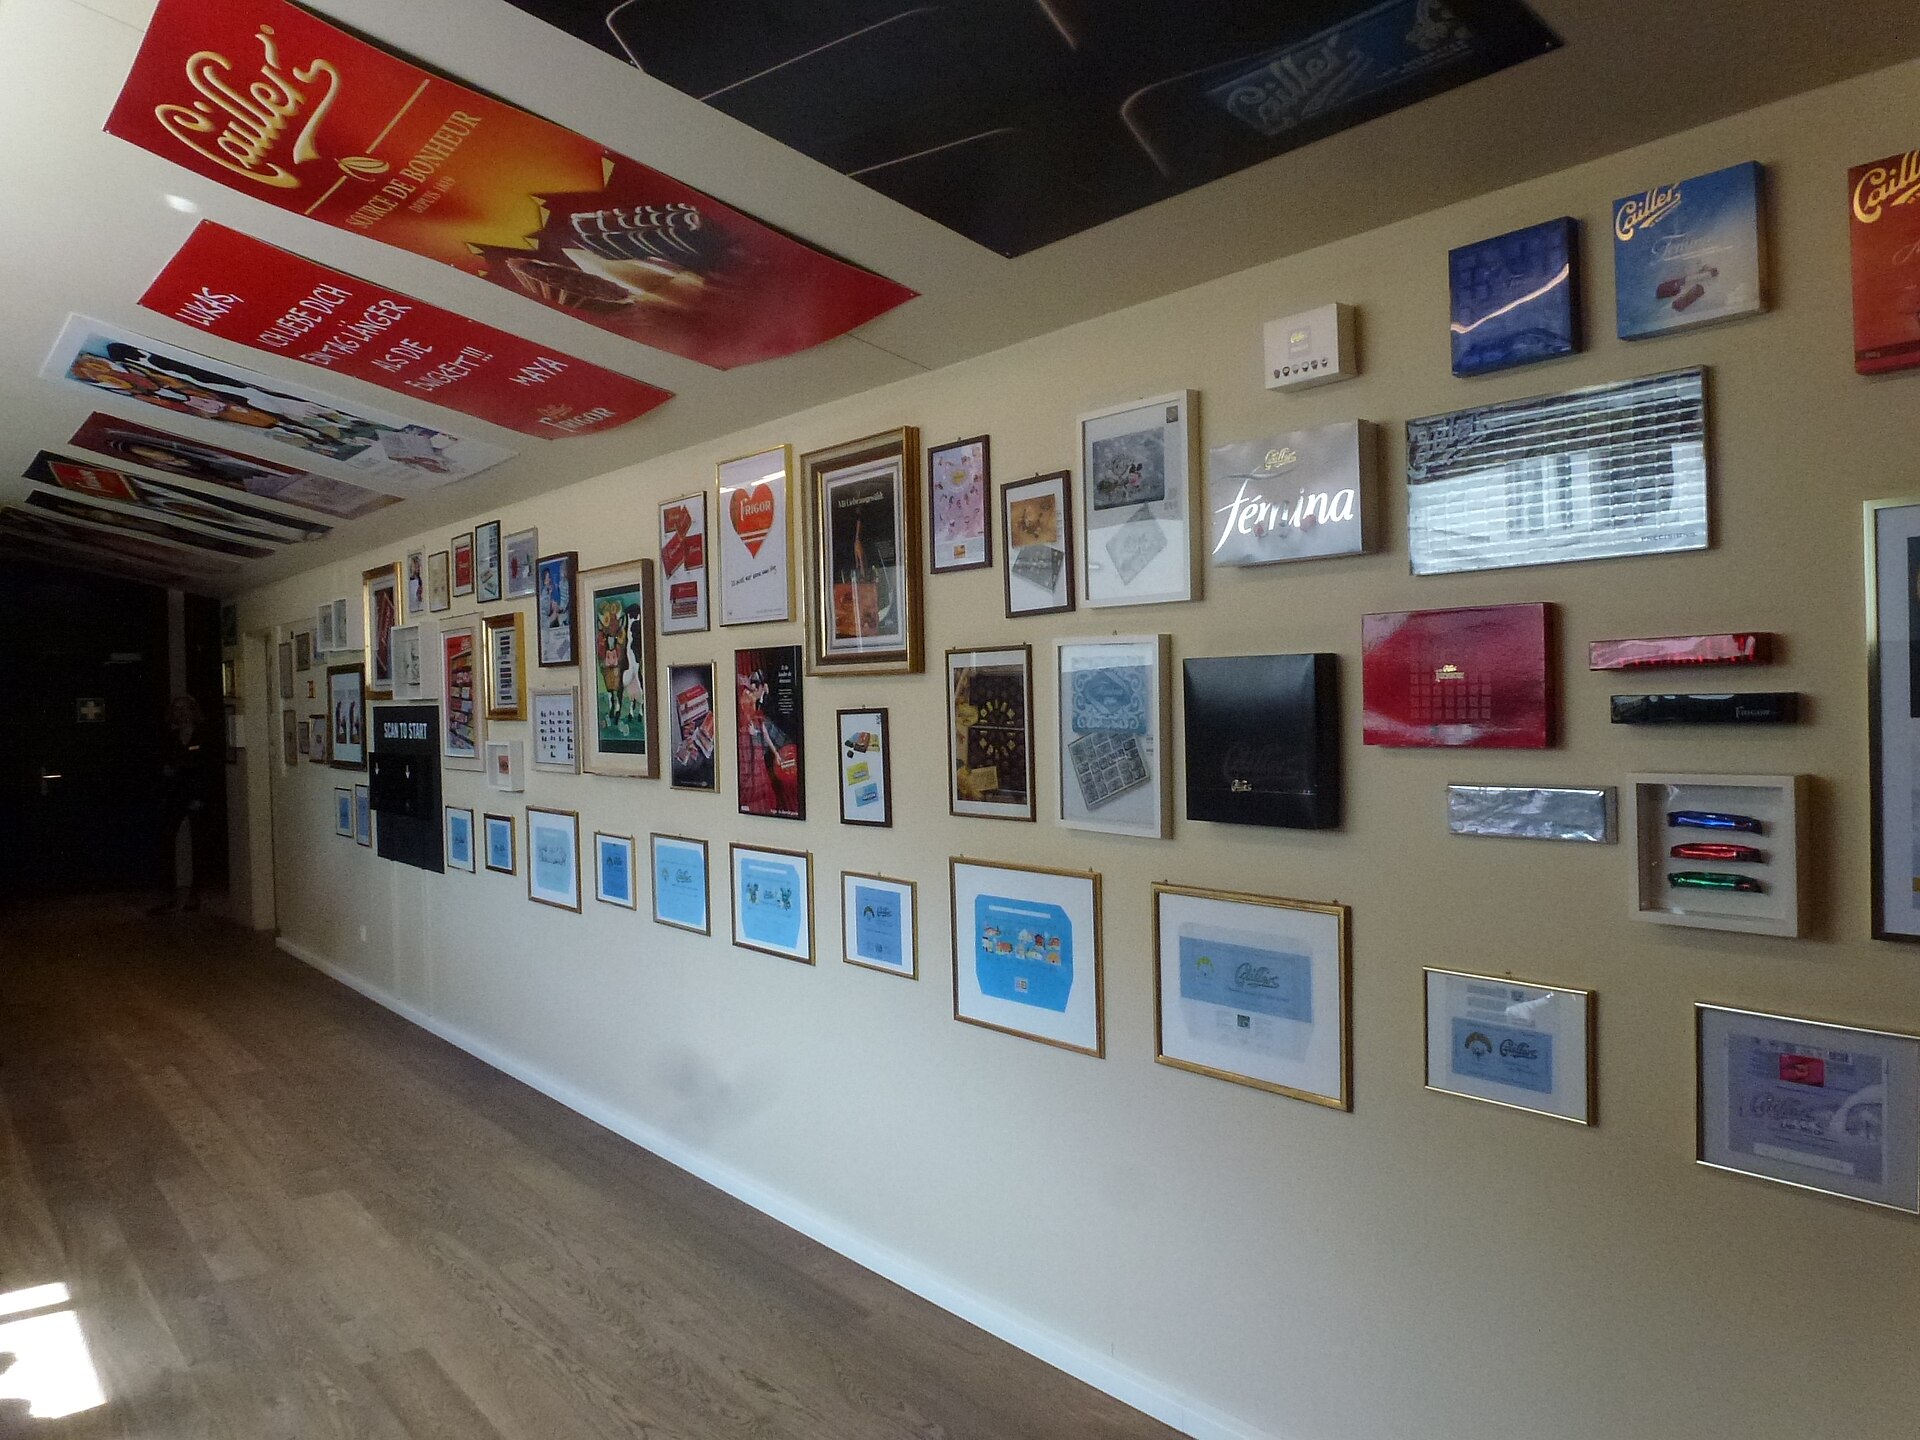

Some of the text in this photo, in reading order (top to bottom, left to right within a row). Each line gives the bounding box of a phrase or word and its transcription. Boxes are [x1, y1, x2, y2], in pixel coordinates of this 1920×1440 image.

[345, 110, 482, 229] SOURCE DE BONHEUR
[1853, 150, 1920, 223] Caill
[407, 190, 442, 214] DEPUIS
[176, 287, 244, 326] LUKAS,
[256, 283, 353, 348] ICH LIEBE DICH
[299, 299, 412, 365] EIN TAG LÄNGER
[371, 338, 433, 373] ALS DIE
[509, 356, 568, 387] MAYA
[740, 497, 771, 521] FRIGOR
[383, 721, 428, 741] SCAN TO START
